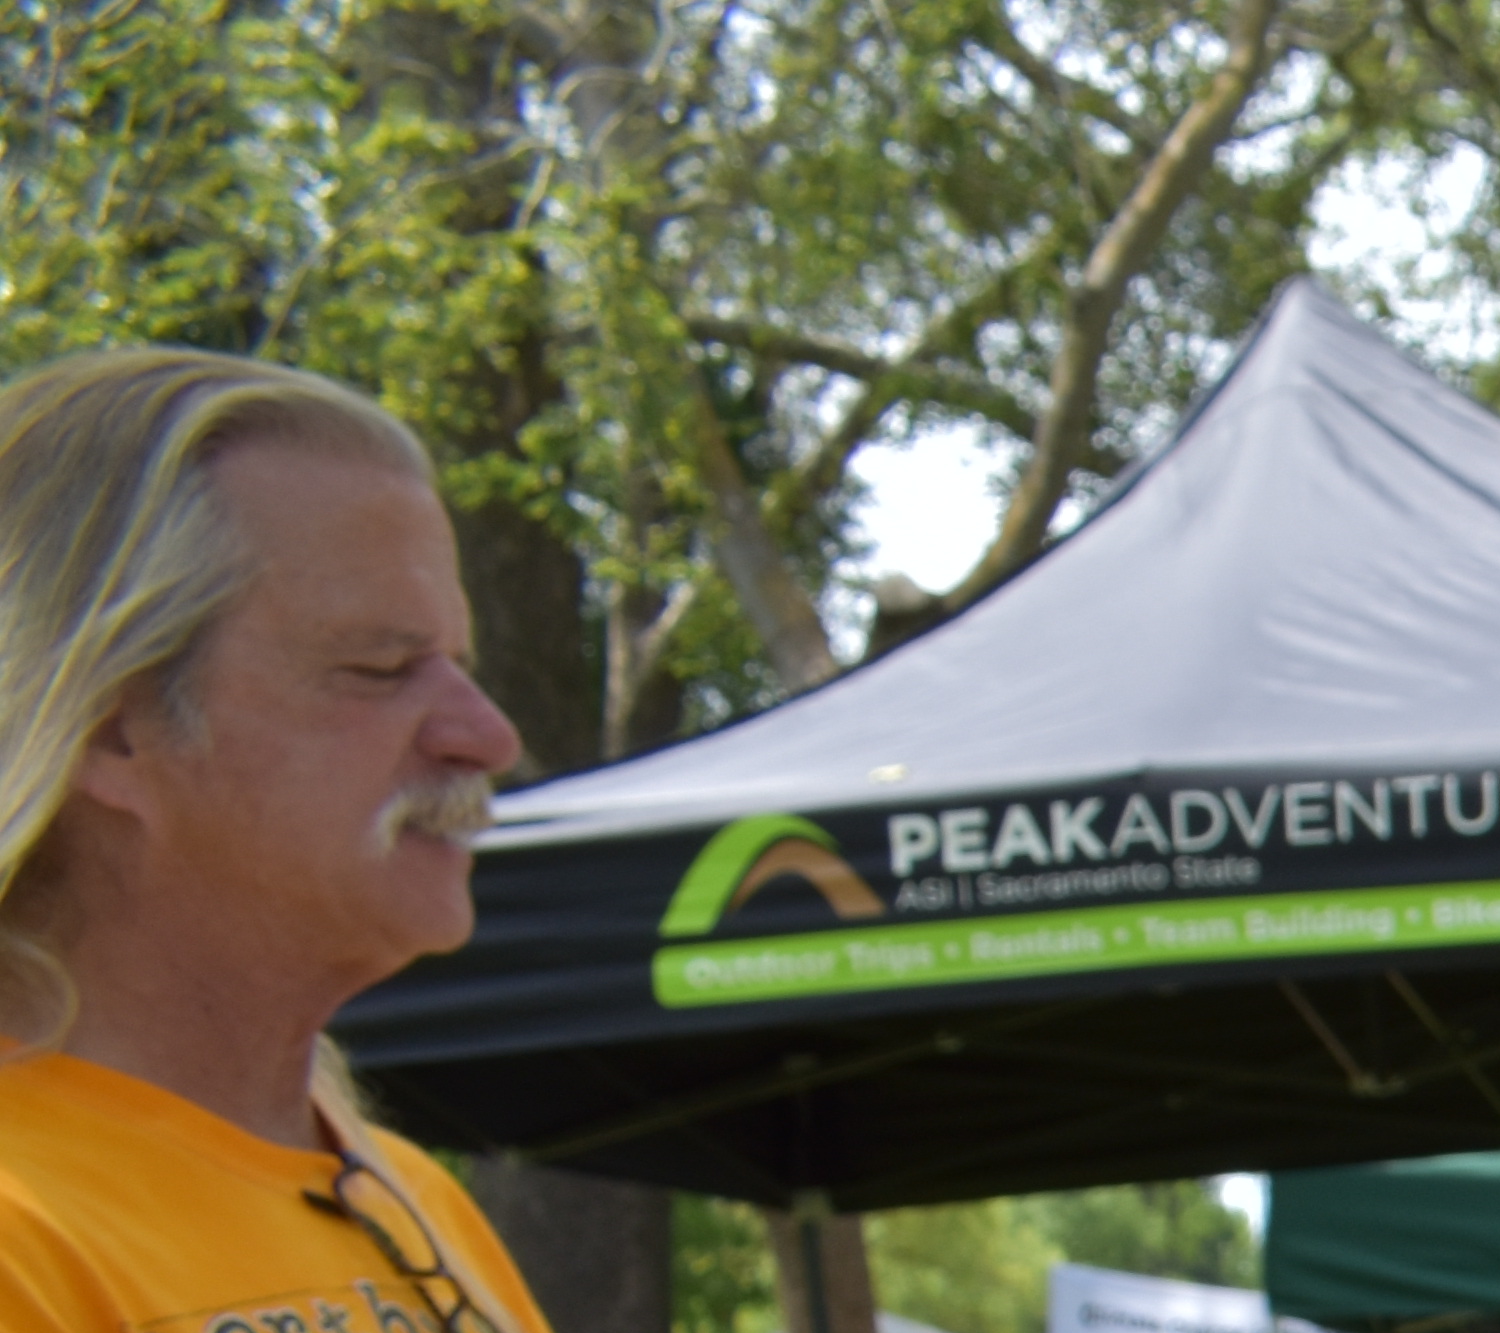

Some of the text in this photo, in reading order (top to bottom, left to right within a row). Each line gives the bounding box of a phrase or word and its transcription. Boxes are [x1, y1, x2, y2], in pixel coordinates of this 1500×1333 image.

[897, 854, 1261, 911] ASI Sacramento State
[682, 949, 835, 991] Outdoor
[845, 938, 935, 975] Trips
[971, 925, 1102, 963] Rentals
[1139, 913, 1238, 947] Team
[1245, 901, 1397, 941] Building
